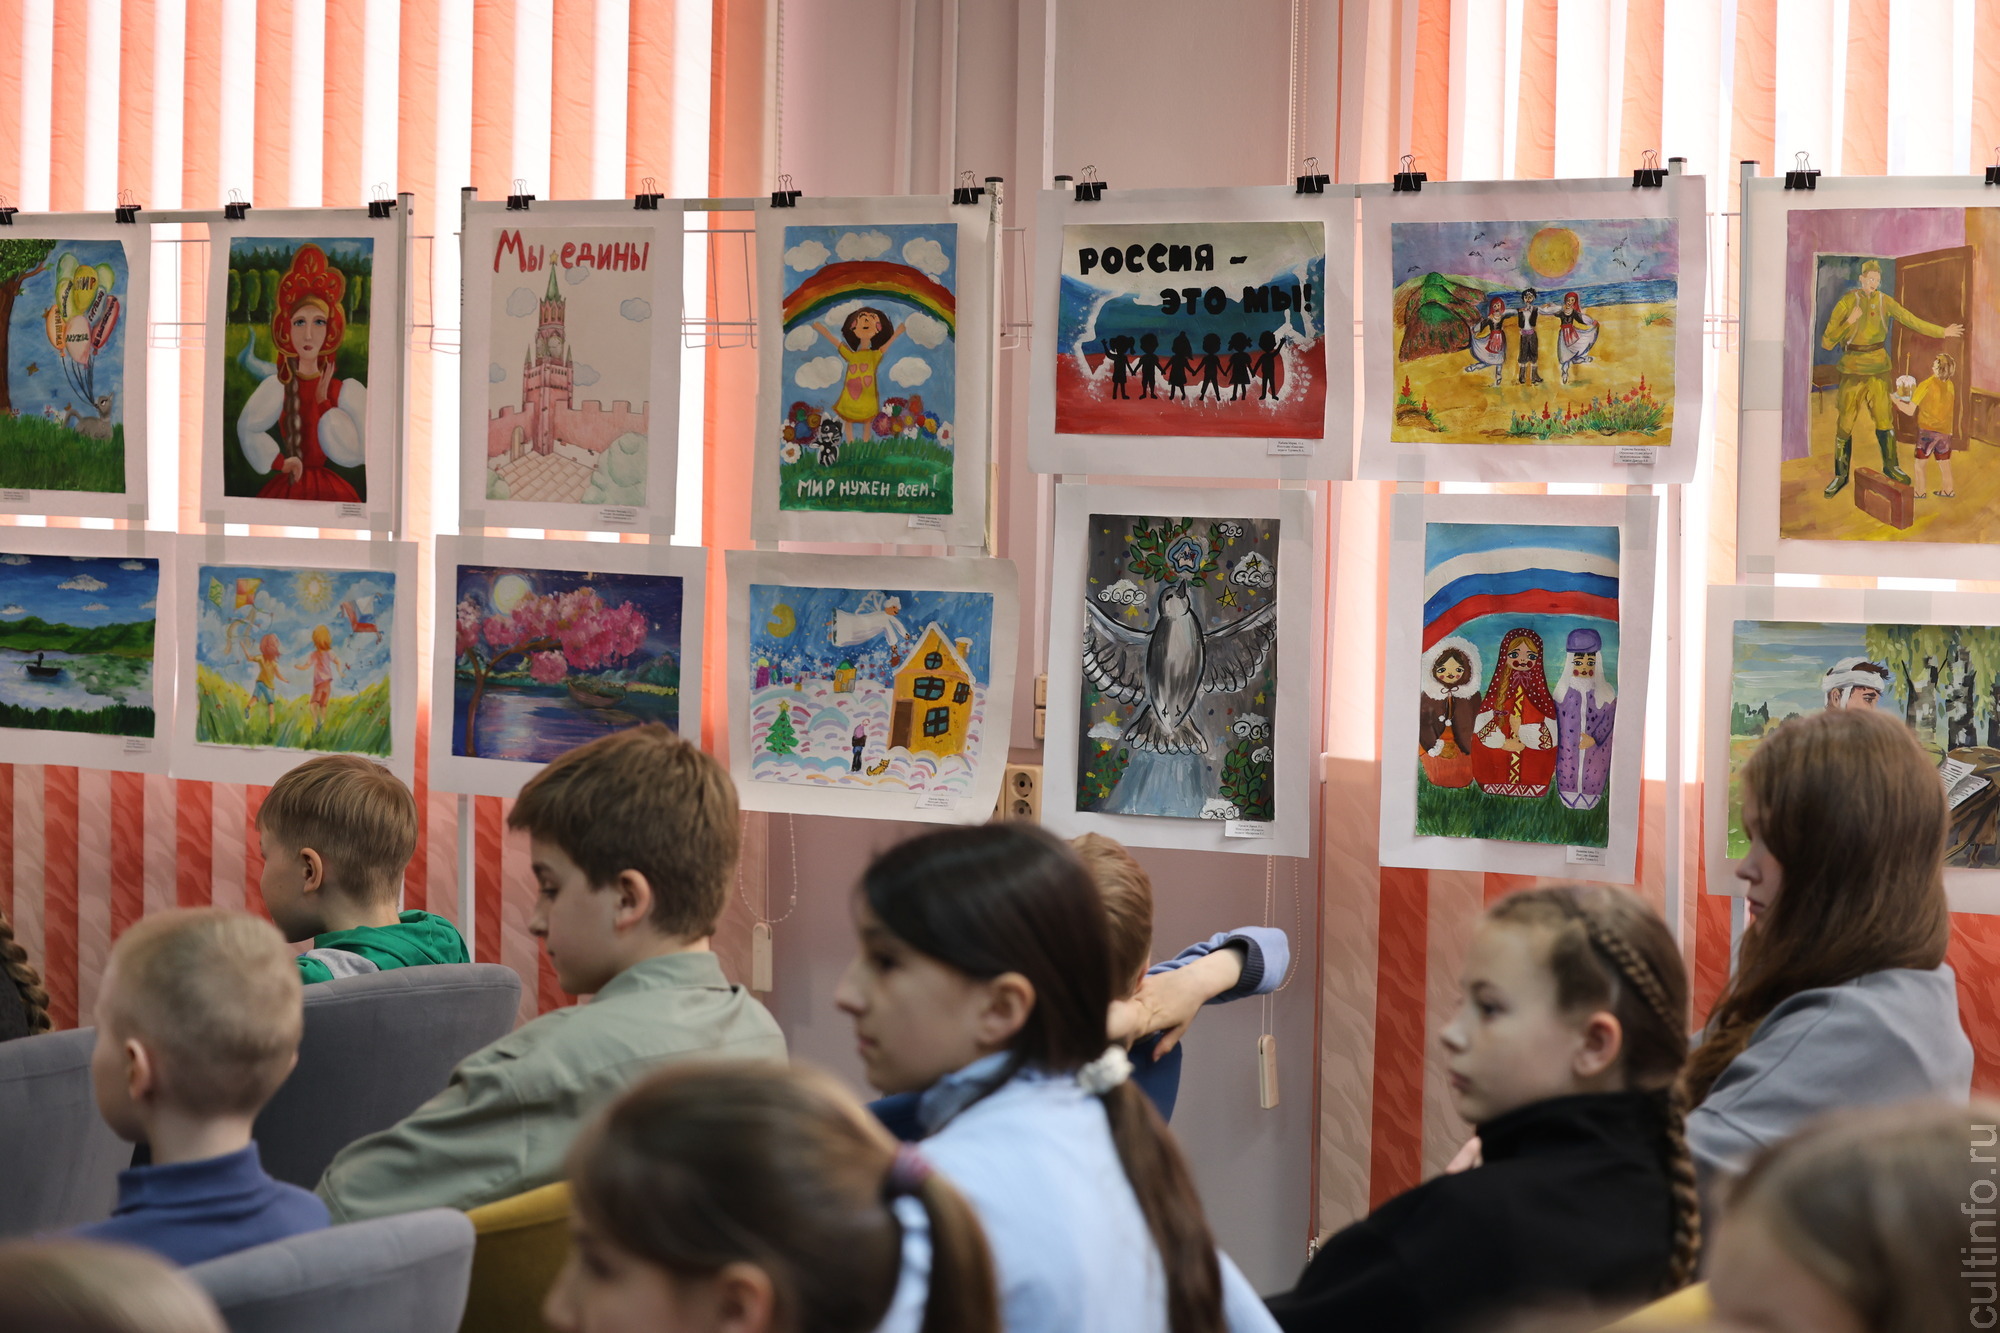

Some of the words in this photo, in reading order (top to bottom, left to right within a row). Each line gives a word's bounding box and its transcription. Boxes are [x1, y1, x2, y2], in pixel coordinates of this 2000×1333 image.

[493, 229, 545, 273] Мы
[560, 241, 650, 273] едины
[1078, 242, 1215, 276] РОССИЯ
[1159, 285, 1228, 315] ЭТО
[1242, 283, 1313, 313] МЫ!
[797, 478, 836, 498] МИР
[839, 480, 891, 498] НУЖЕН
[897, 473, 938, 498] ВСЕМ!
